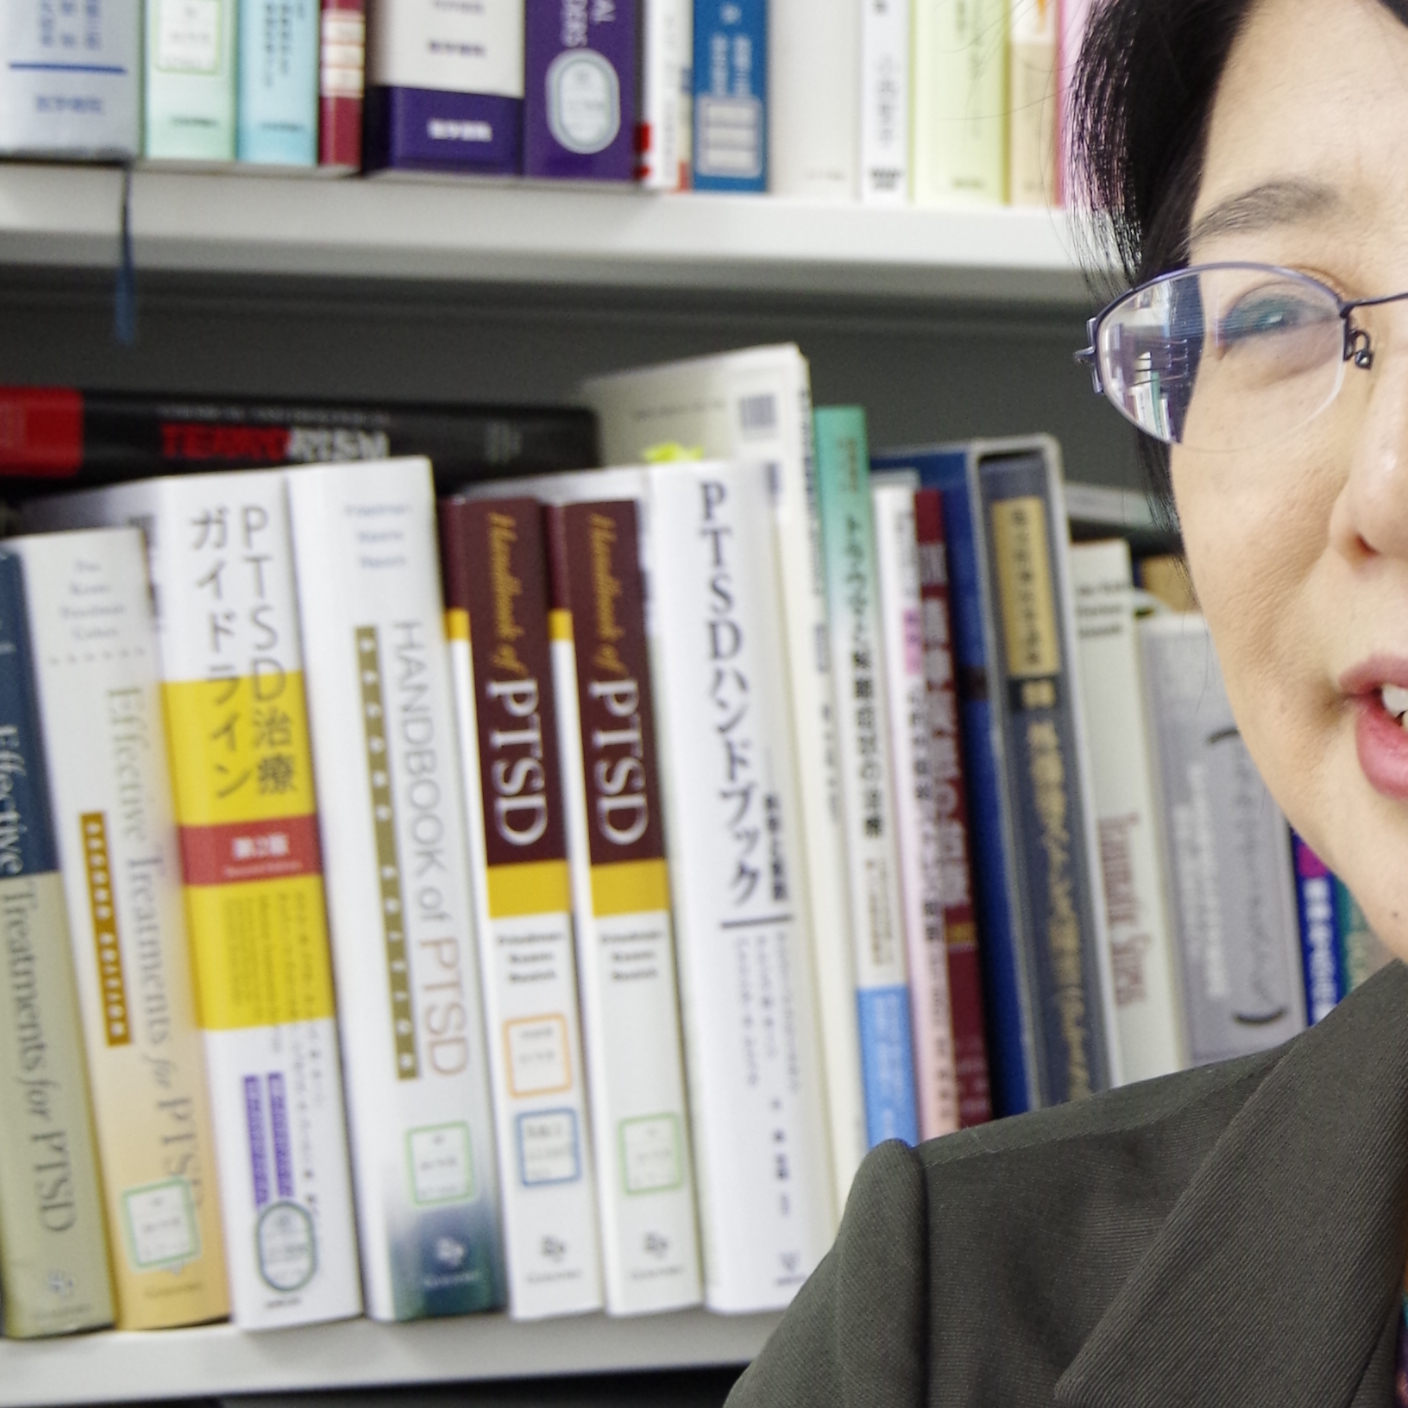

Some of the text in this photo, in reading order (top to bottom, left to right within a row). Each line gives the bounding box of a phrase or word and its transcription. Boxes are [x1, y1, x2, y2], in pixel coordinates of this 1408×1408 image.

[190, 505, 255, 800] ガイドライン
[241, 505, 298, 796] PTSD治療
[488, 512, 526, 642] Handbook
[587, 512, 625, 642] Handbook
[107, 682, 150, 845] Effective
[394, 619, 447, 877] HANDBOOK
[486, 677, 549, 847] PTSD
[587, 678, 650, 847] PTSD
[699, 479, 762, 906] PTSDハンドブック
[3, 877, 49, 1072] Treatments
[126, 848, 172, 1053] Treatments
[418, 936, 470, 1079] PTSD
[18, 1074, 54, 1122] for
[31, 1127, 78, 1235] PTSD
[156, 1093, 204, 1210] PTS
